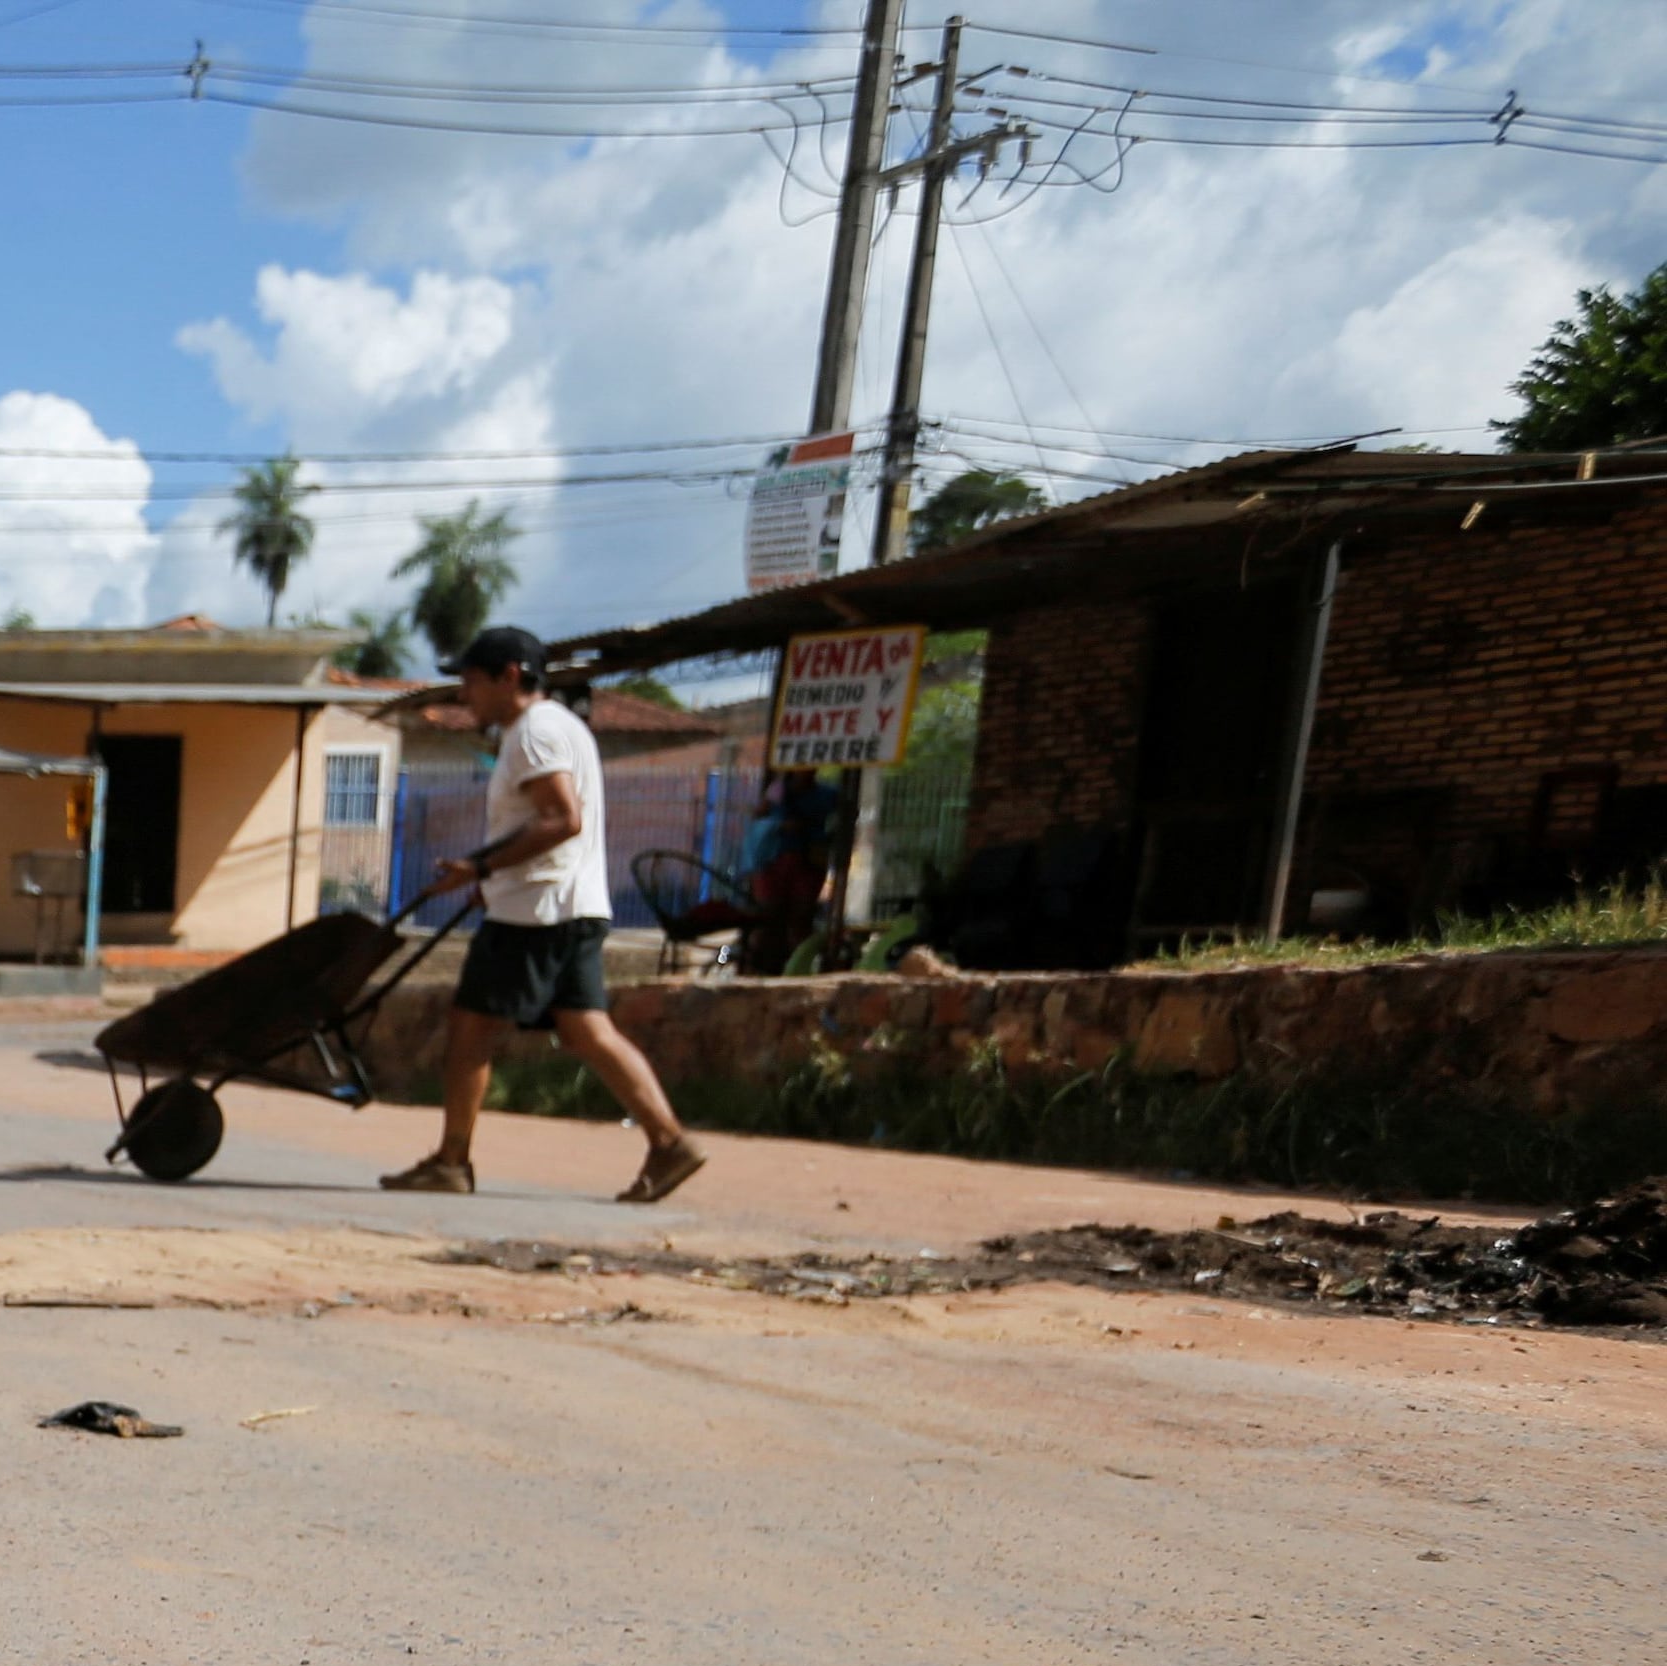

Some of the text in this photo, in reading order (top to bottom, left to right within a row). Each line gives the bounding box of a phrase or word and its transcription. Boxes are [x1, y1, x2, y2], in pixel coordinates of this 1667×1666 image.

[790, 636, 884, 679] VENTA
[779, 705, 894, 735] MATE Y
